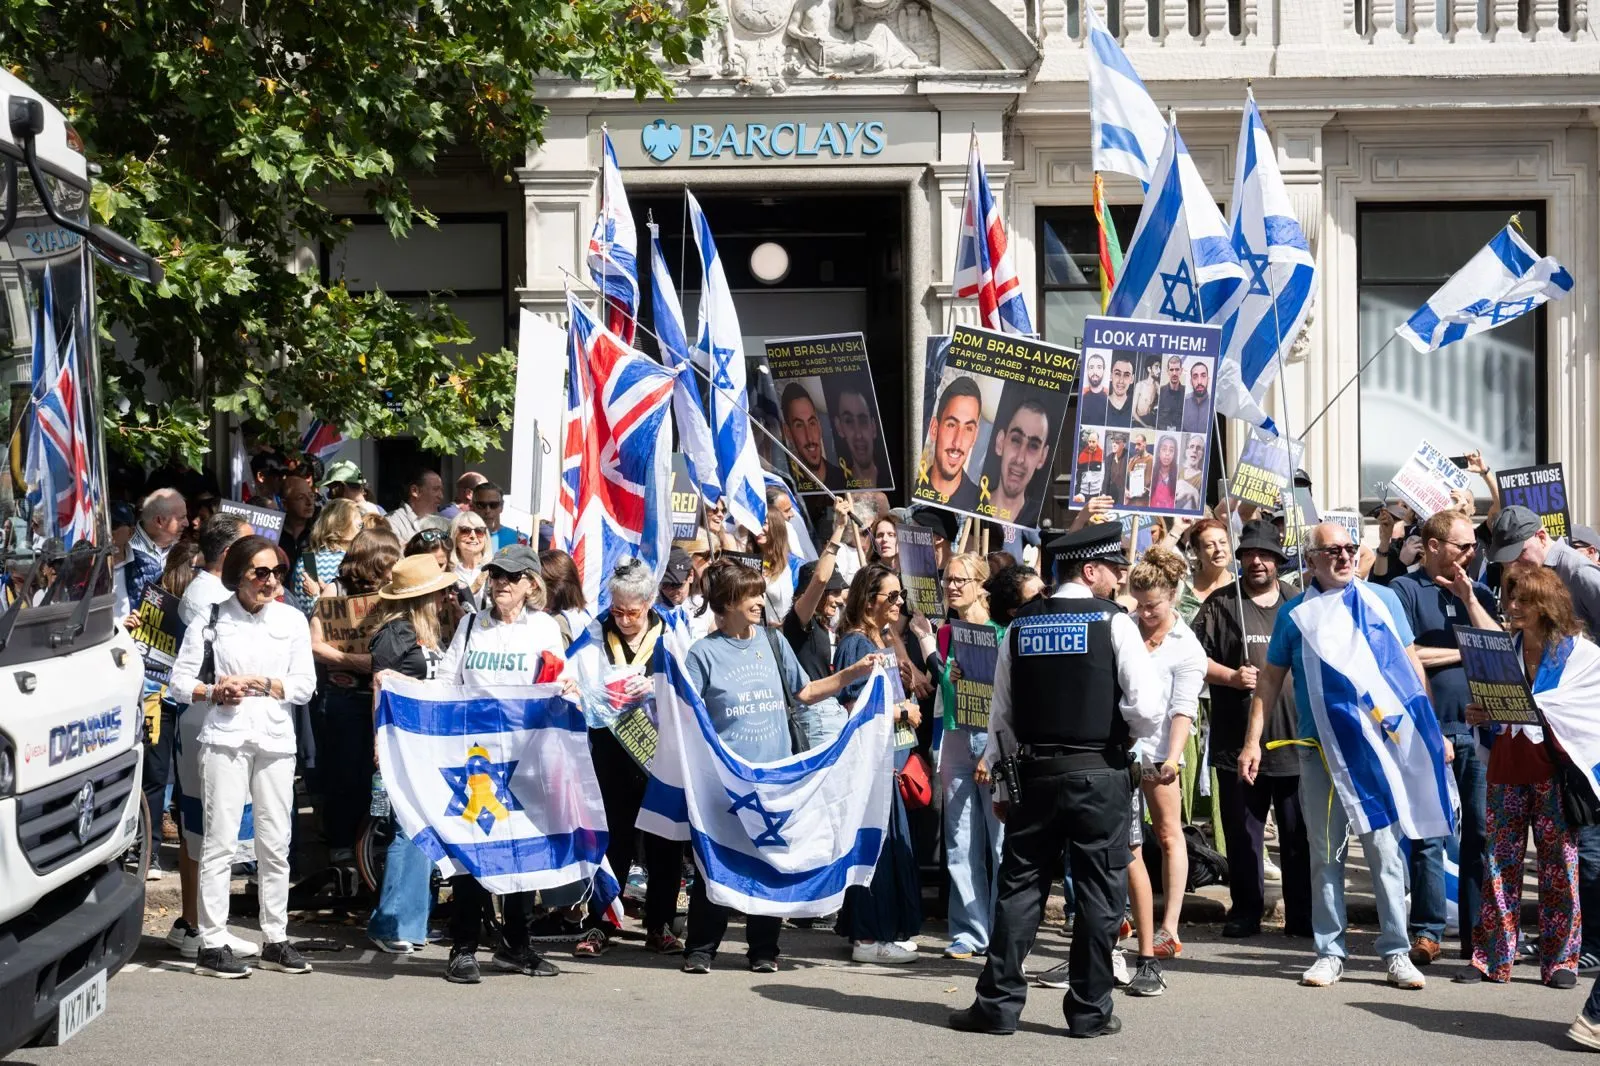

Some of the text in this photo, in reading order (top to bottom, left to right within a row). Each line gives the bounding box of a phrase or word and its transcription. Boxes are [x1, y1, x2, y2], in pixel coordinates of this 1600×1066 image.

[690, 121, 885, 158] BARCLAYS
[767, 341, 865, 359] ROM BRASLAVSKI
[1094, 329, 1135, 347] LOOK
[1137, 332, 1156, 348] AT
[1159, 334, 1207, 352] THEM!
[953, 331, 983, 349] ROM
[986, 339, 1077, 371] BRASLAVSKI
[769, 360, 800, 369] STARVED
[832, 354, 867, 364] TORTURED
[791, 367, 807, 376] YOUR
[809, 367, 833, 375] HEROES
[844, 364, 861, 372] GAZA
[949, 346, 987, 361] STARVED
[995, 357, 1022, 370] CAGED
[1030, 365, 1073, 382] TORTURED
[955, 359, 1060, 391] BY YOUR HEROES IN GAZA
[846, 480, 861, 488] AGE
[1235, 474, 1246, 486] TO
[1247, 477, 1264, 492] FEEL
[1238, 462, 1288, 488] DEMANDING
[1500, 468, 1561, 489] WE'RE THOSE
[798, 482, 813, 490] AGE
[914, 487, 950, 503] AGE 19
[1231, 484, 1242, 497] IN
[1242, 487, 1275, 508] LONDON
[1504, 482, 1566, 513] JEWS
[252, 511, 282, 530] THOSE
[976, 503, 1012, 520] AGE 21
[914, 531, 933, 546] THOSE
[139, 600, 165, 629] JEW
[320, 599, 348, 619] UN
[323, 622, 366, 642] Hamas
[952, 625, 996, 647] WE'RE THOSE
[1022, 626, 1084, 635] METROPOLITAN
[1020, 633, 1084, 653] POLICE
[1456, 631, 1512, 652] WE'RE THOSE
[465, 649, 528, 672] ZIONIST.
[738, 688, 774, 703] WE WILL
[1469, 680, 1527, 698] DEMANDING
[725, 700, 785, 718] DANCE AGAIN
[957, 694, 967, 709] TO
[968, 697, 982, 711] FEEL
[1484, 696, 1505, 710] FEEL
[1506, 697, 1532, 710] SAFE
[957, 709, 966, 724] IN
[1487, 709, 1529, 721] LONDON
[616, 724, 650, 765] LONDON
